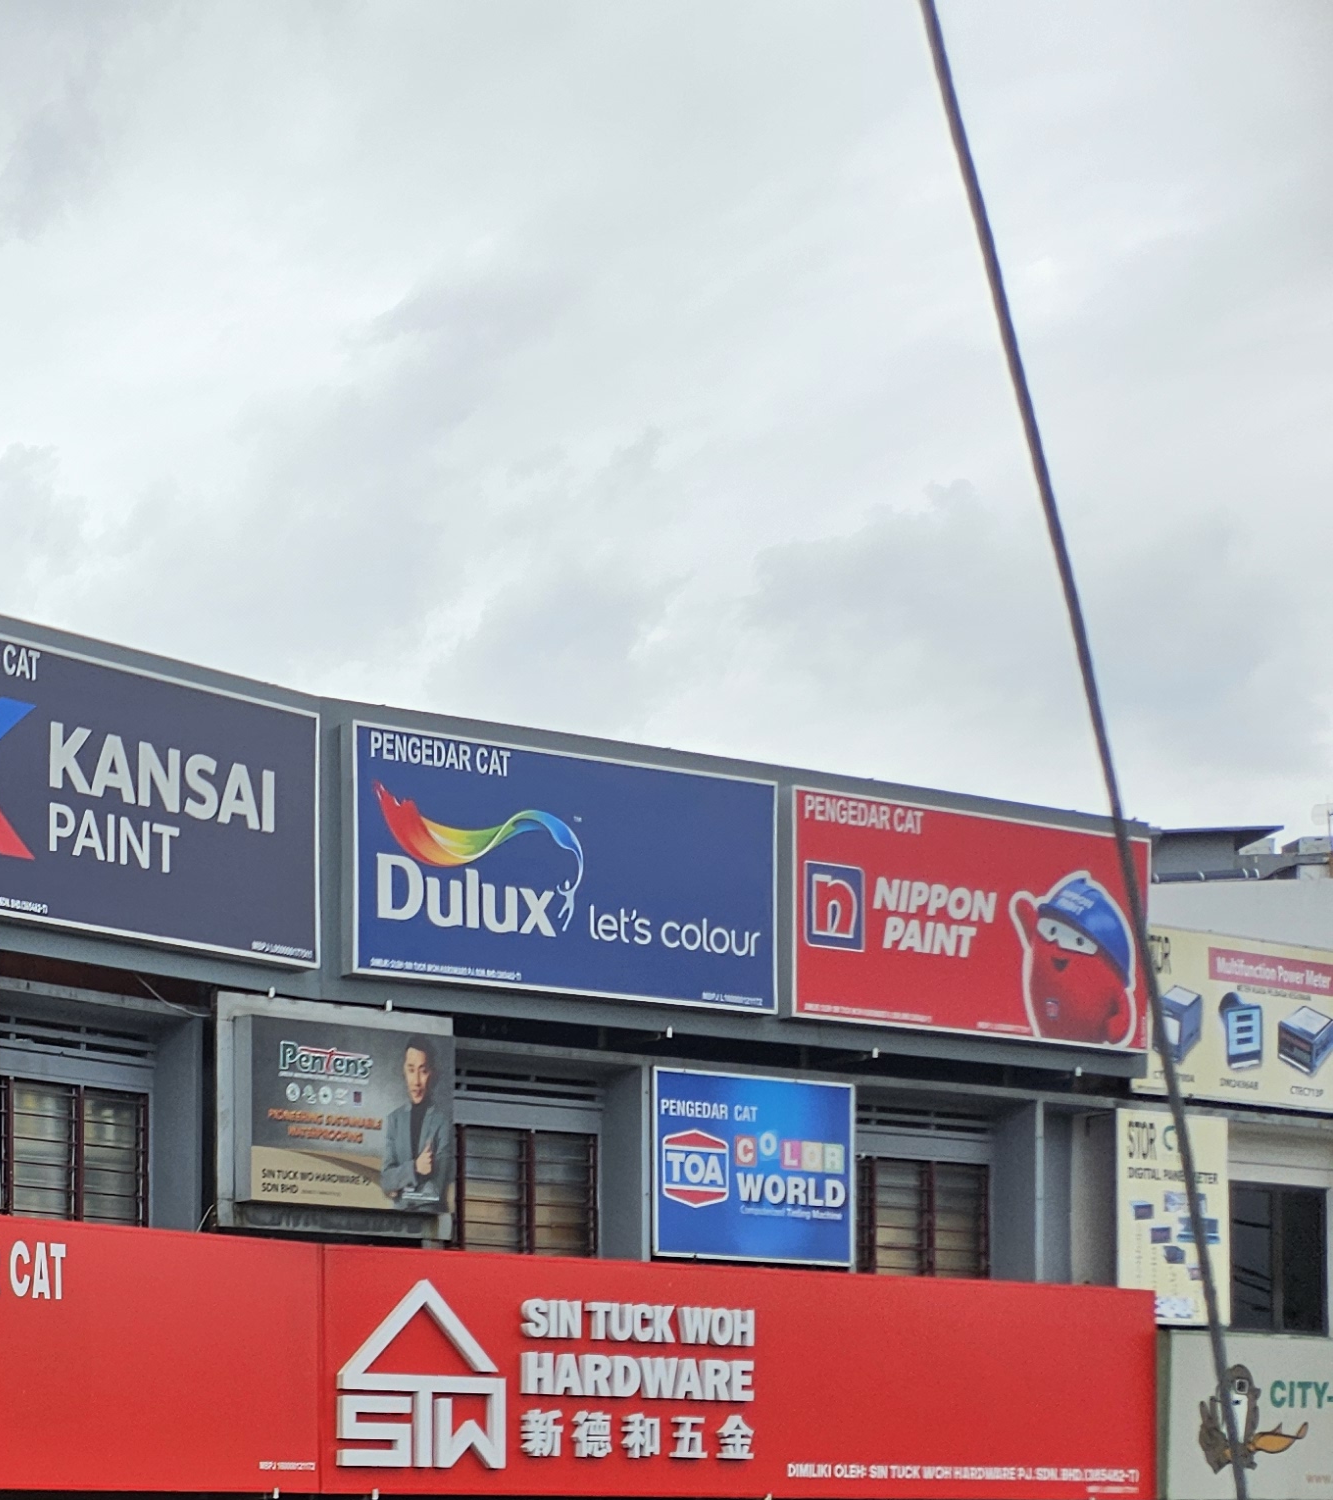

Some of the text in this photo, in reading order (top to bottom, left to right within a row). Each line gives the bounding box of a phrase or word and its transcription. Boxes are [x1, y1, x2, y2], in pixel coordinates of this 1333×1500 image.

[3, 644, 41, 682] CAT
[48, 721, 275, 834] KANSAI
[370, 731, 511, 778] PENGEDAR CAT
[48, 802, 180, 874] PAINT
[804, 794, 924, 835] PENGEDAR CAT
[376, 852, 761, 958] Dulux let's colour
[873, 877, 997, 925] NIPPON
[882, 917, 978, 959] PAINT
[1216, 956, 1332, 989] Multifunction Power Meter
[279, 1040, 373, 1079] Pentens
[660, 1098, 758, 1122] PENGEDAR CAT
[666, 1152, 724, 1185] TOA
[736, 1172, 845, 1208] WORLD
[9, 1240, 67, 1300] CAT
[521, 1298, 755, 1347] SIN TUCK WOH
[520, 1351, 755, 1402] HARDWARE
[520, 1408, 755, 1460] 新德和五金
